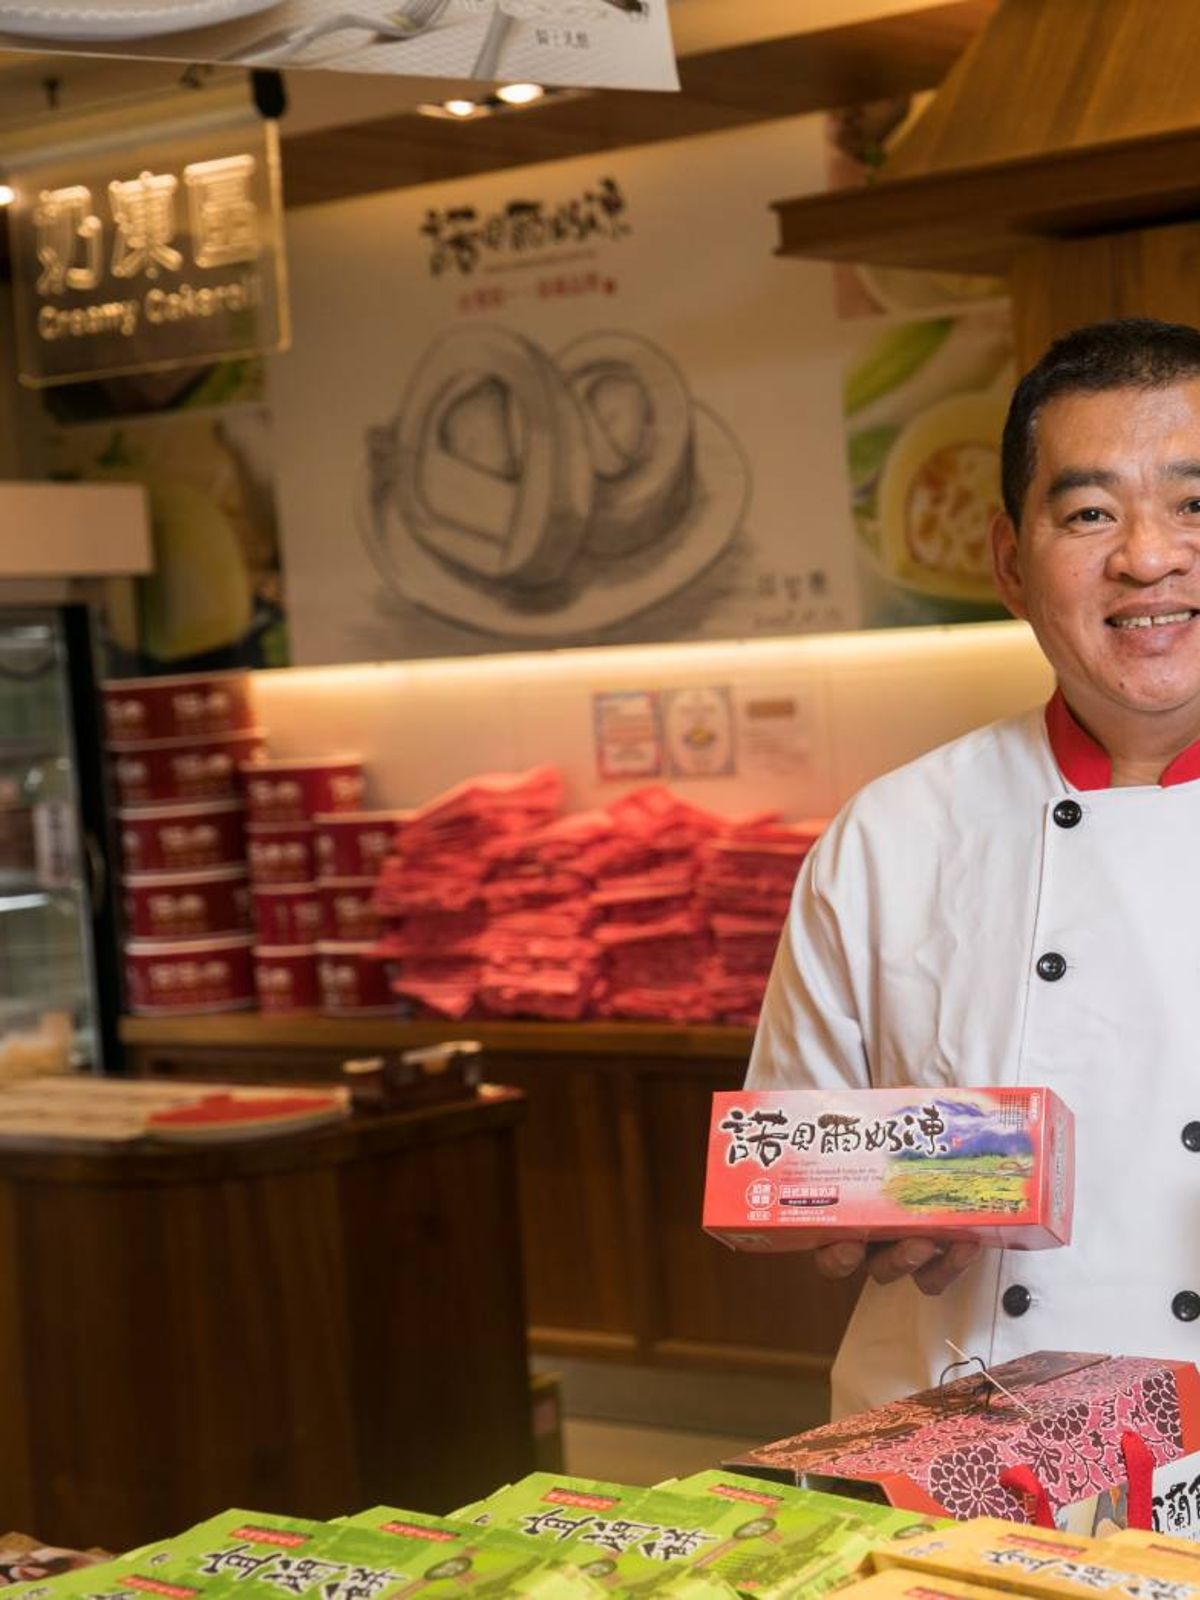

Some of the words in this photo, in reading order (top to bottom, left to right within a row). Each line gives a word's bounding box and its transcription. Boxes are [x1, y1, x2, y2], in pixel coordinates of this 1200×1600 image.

[721, 1105, 947, 1167] 諾貝爾奶凍
